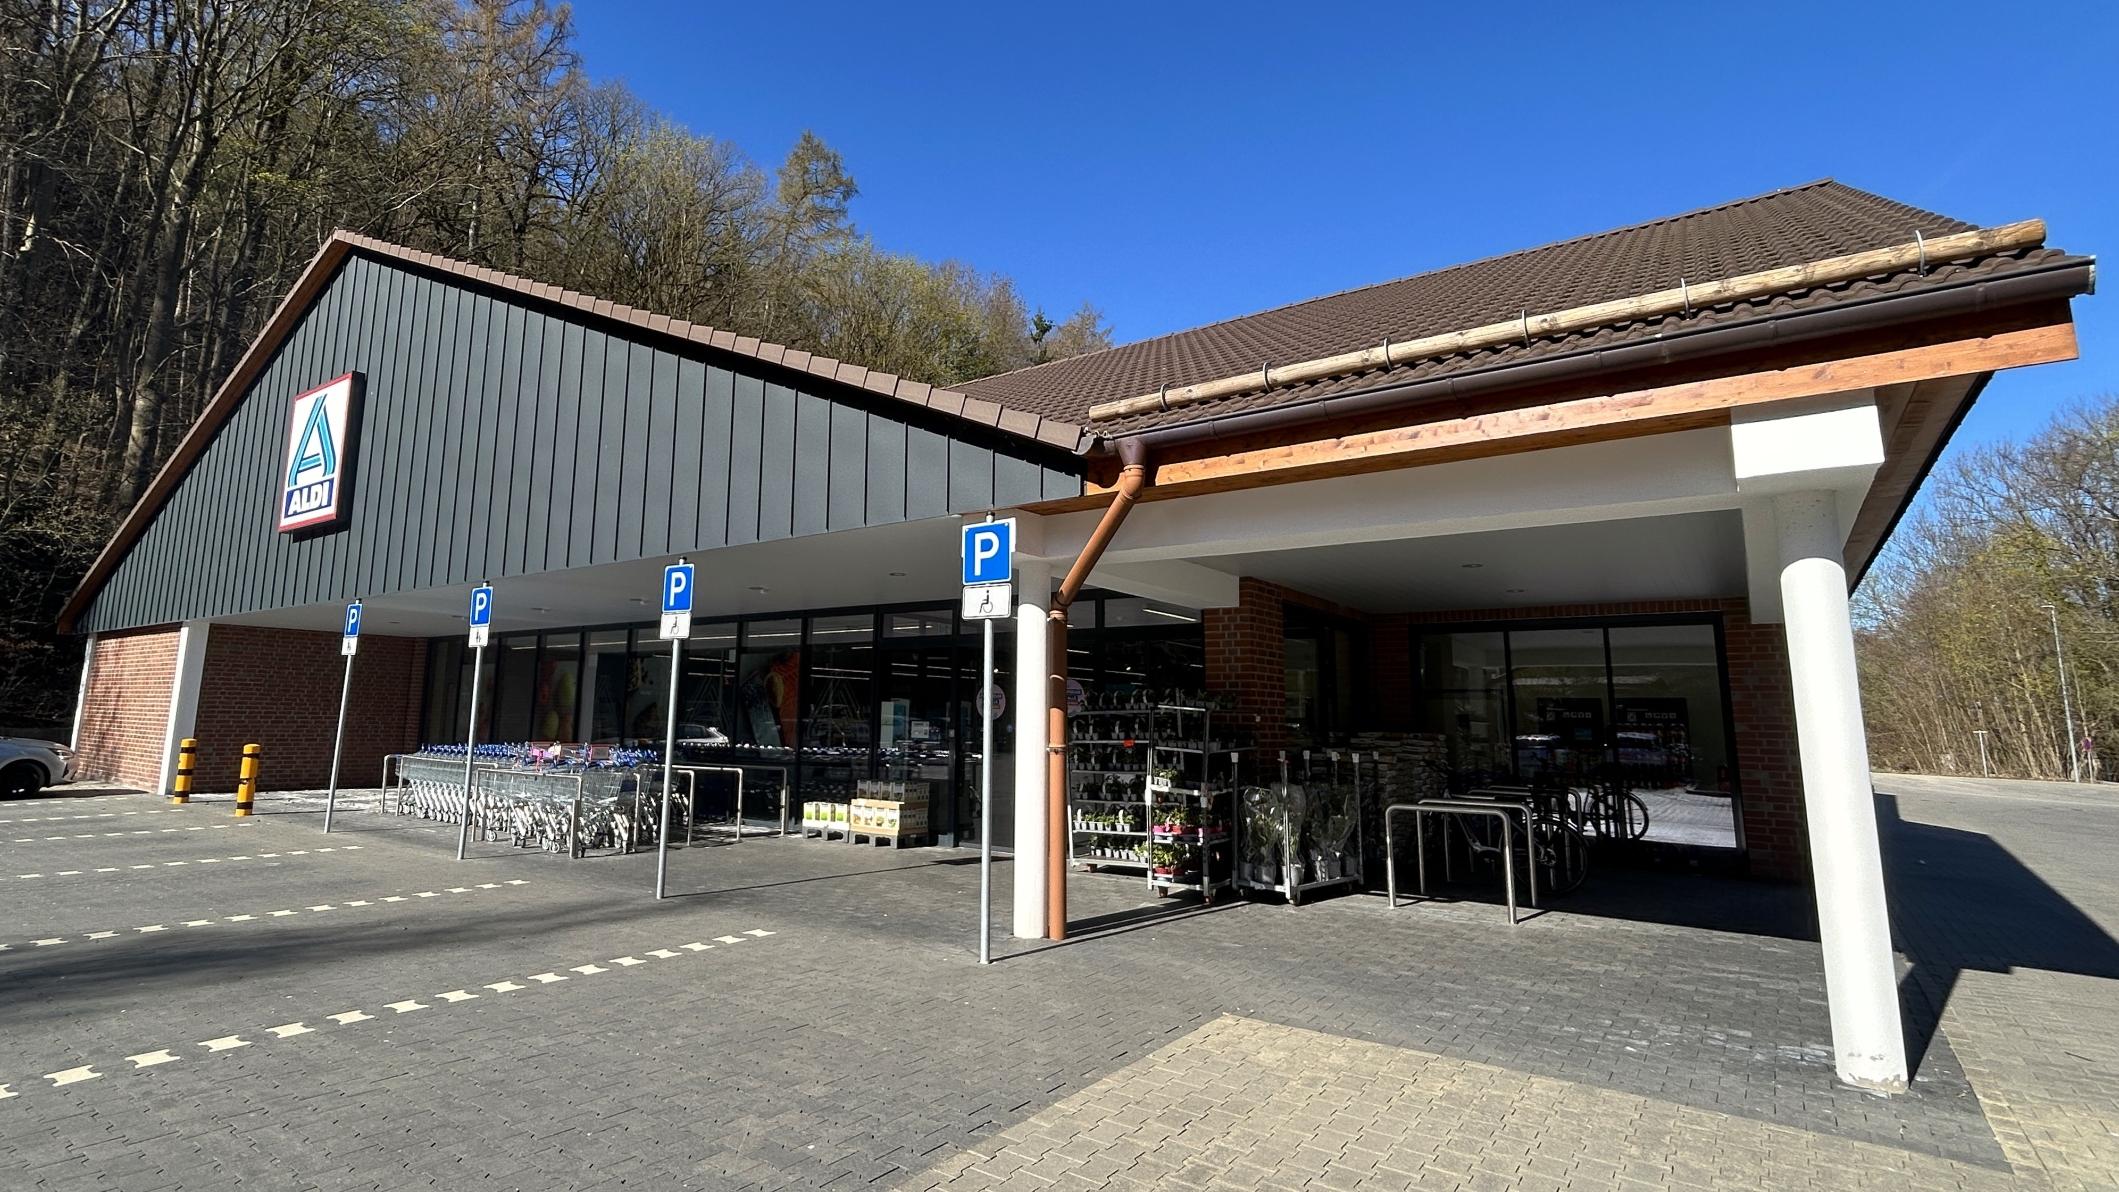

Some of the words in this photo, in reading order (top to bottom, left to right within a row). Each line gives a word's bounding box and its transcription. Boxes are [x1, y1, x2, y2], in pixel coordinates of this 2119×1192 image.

[287, 480, 330, 516] ALDI
[974, 531, 1000, 576] P
[475, 592, 487, 622] P
[669, 571, 687, 607] P
[347, 608, 358, 633] P
